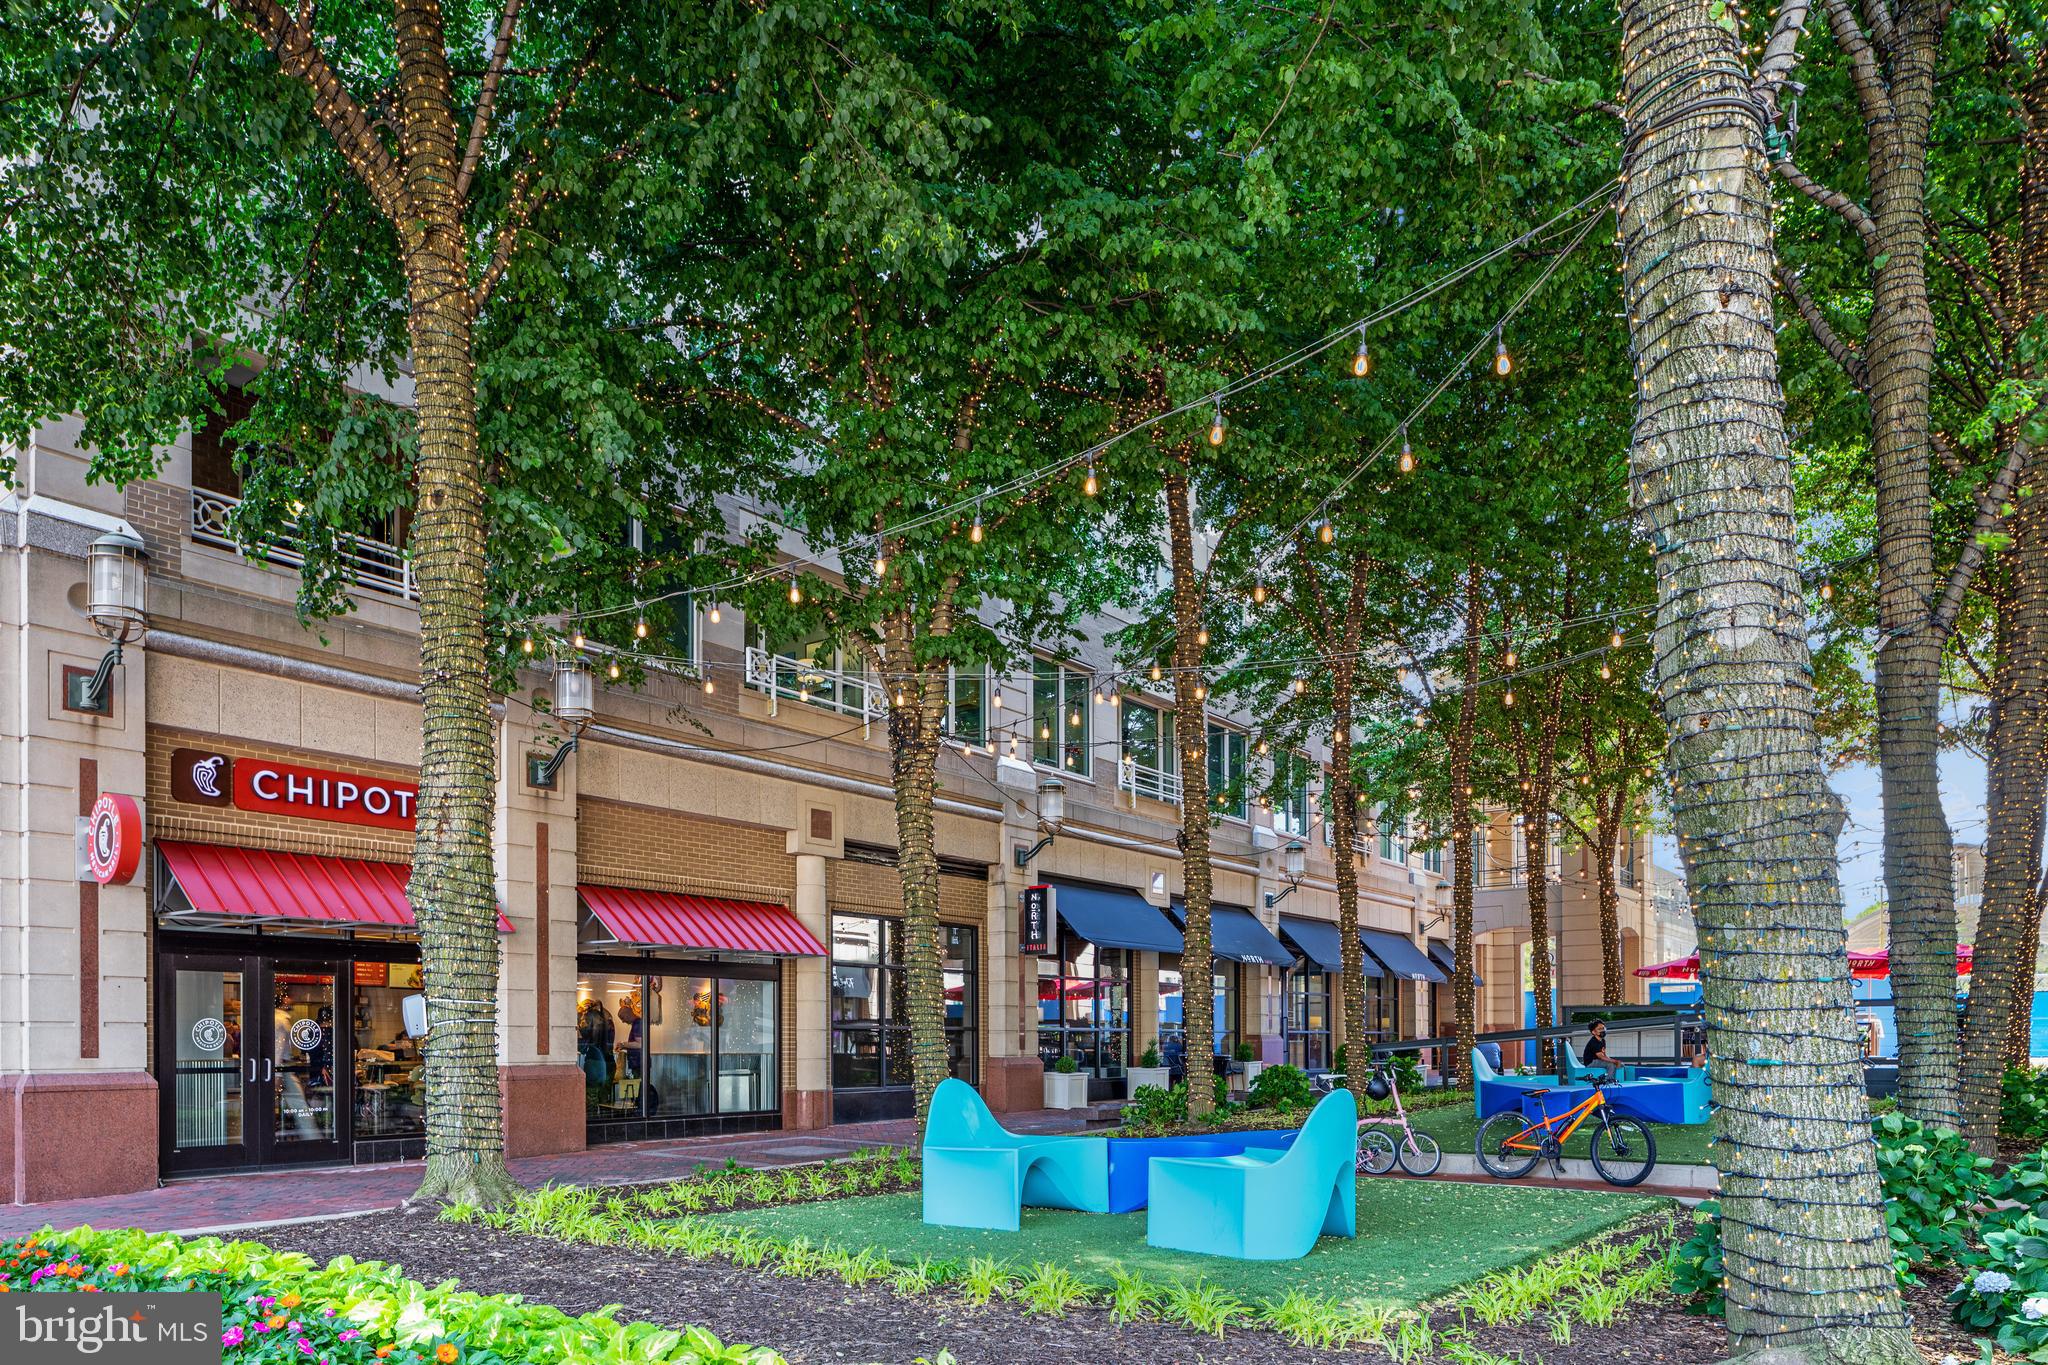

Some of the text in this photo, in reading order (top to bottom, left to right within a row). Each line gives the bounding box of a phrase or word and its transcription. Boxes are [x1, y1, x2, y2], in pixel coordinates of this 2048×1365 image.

[253, 770, 414, 817] CHIPOT
[89, 797, 119, 836] CHIPOTLE
[1031, 893, 1039, 940] NORTH
[1241, 954, 1264, 964] NORTH
[195, 1020, 223, 1032] CHIPOTLE
[294, 1020, 319, 1032] CHIPOTLE
